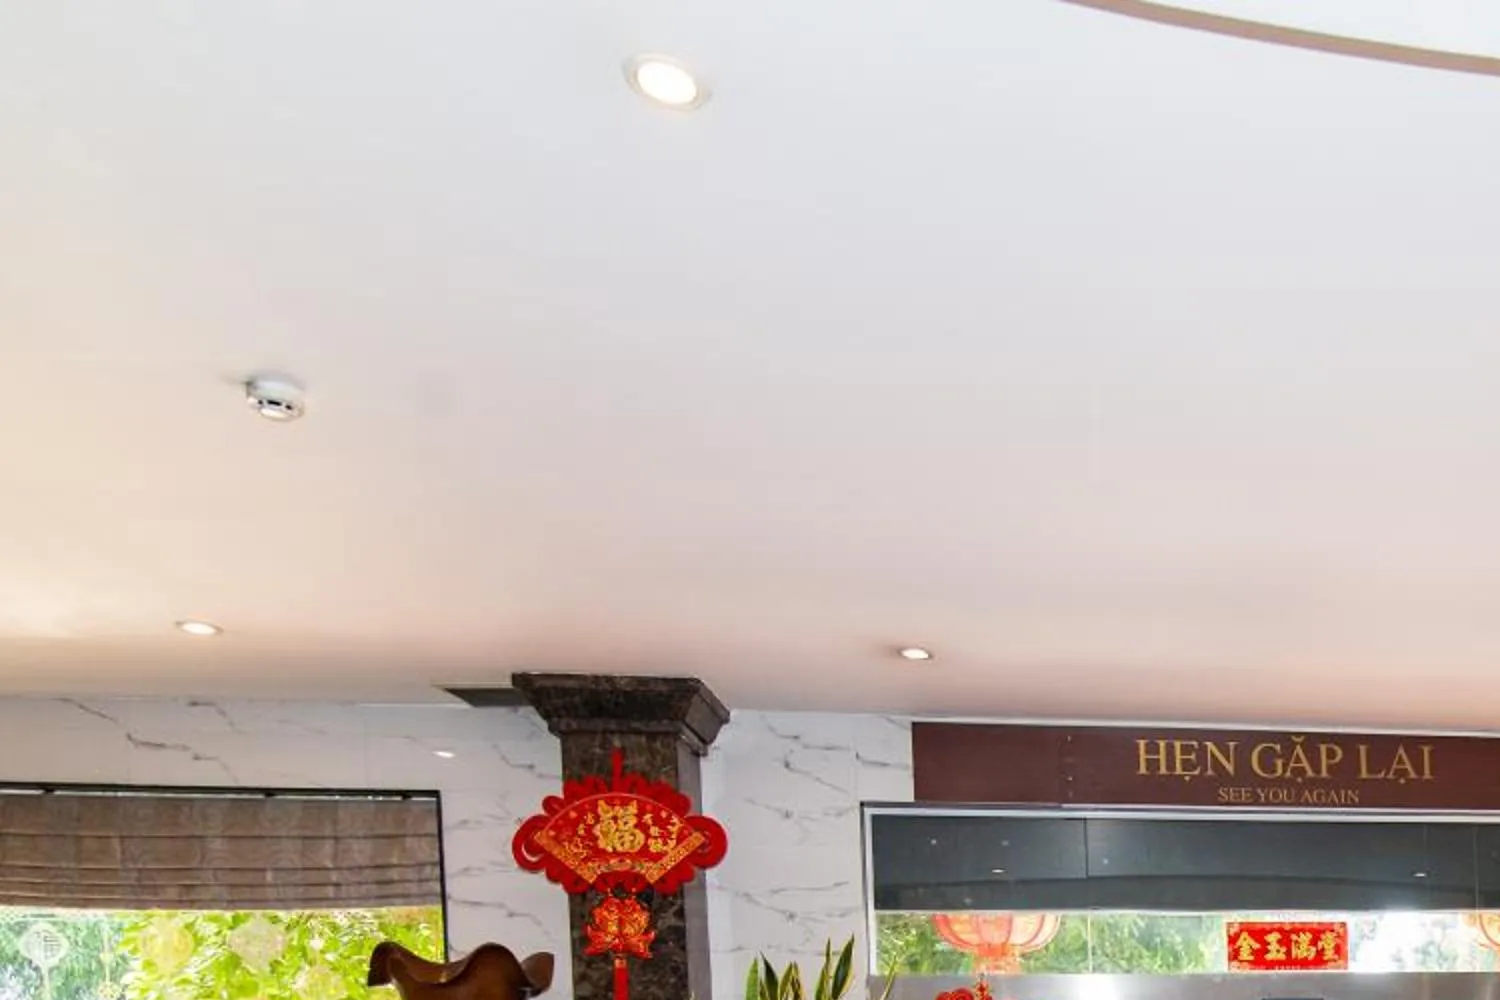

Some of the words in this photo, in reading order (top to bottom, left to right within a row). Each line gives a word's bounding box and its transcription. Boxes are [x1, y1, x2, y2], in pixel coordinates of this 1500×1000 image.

[1135, 738, 1239, 782] HẸN
[1250, 735, 1343, 783] GẶP
[1356, 743, 1435, 784] LẠI
[1217, 786, 1252, 803] SEE
[1256, 787, 1295, 803] YOU
[1300, 789, 1360, 805] AGAIN
